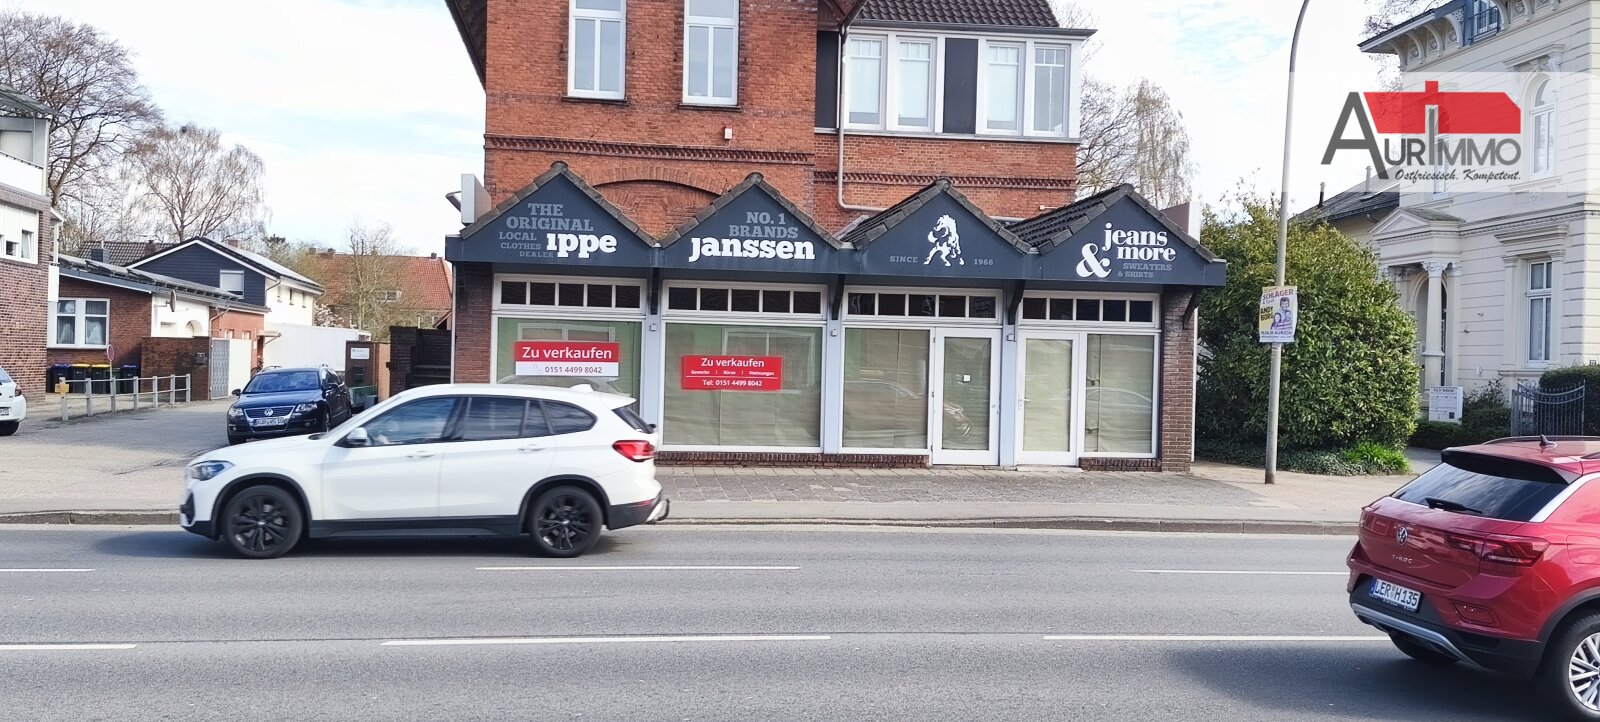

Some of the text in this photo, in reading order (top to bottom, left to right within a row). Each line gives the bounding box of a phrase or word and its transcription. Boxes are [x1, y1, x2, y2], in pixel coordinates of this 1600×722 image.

[528, 202, 563, 216] THE
[506, 216, 594, 231] ORIGINAL
[746, 212, 786, 225] NO. 1
[499, 231, 536, 240] LOCAL
[729, 225, 799, 239] BRANDS
[1102, 222, 1168, 251] jeans
[500, 242, 541, 250] CLOTHES
[688, 237, 815, 262] janssen
[1076, 243, 1176, 278] & more
[1122, 263, 1173, 271] SWEATERS
[522, 347, 612, 359] Zu verkaufen
[701, 358, 765, 368] Zu verkaufen
[584, 366, 603, 374] 8042
[1392, 554, 1412, 564] T-ROC
[1375, 581, 1391, 597] LER
